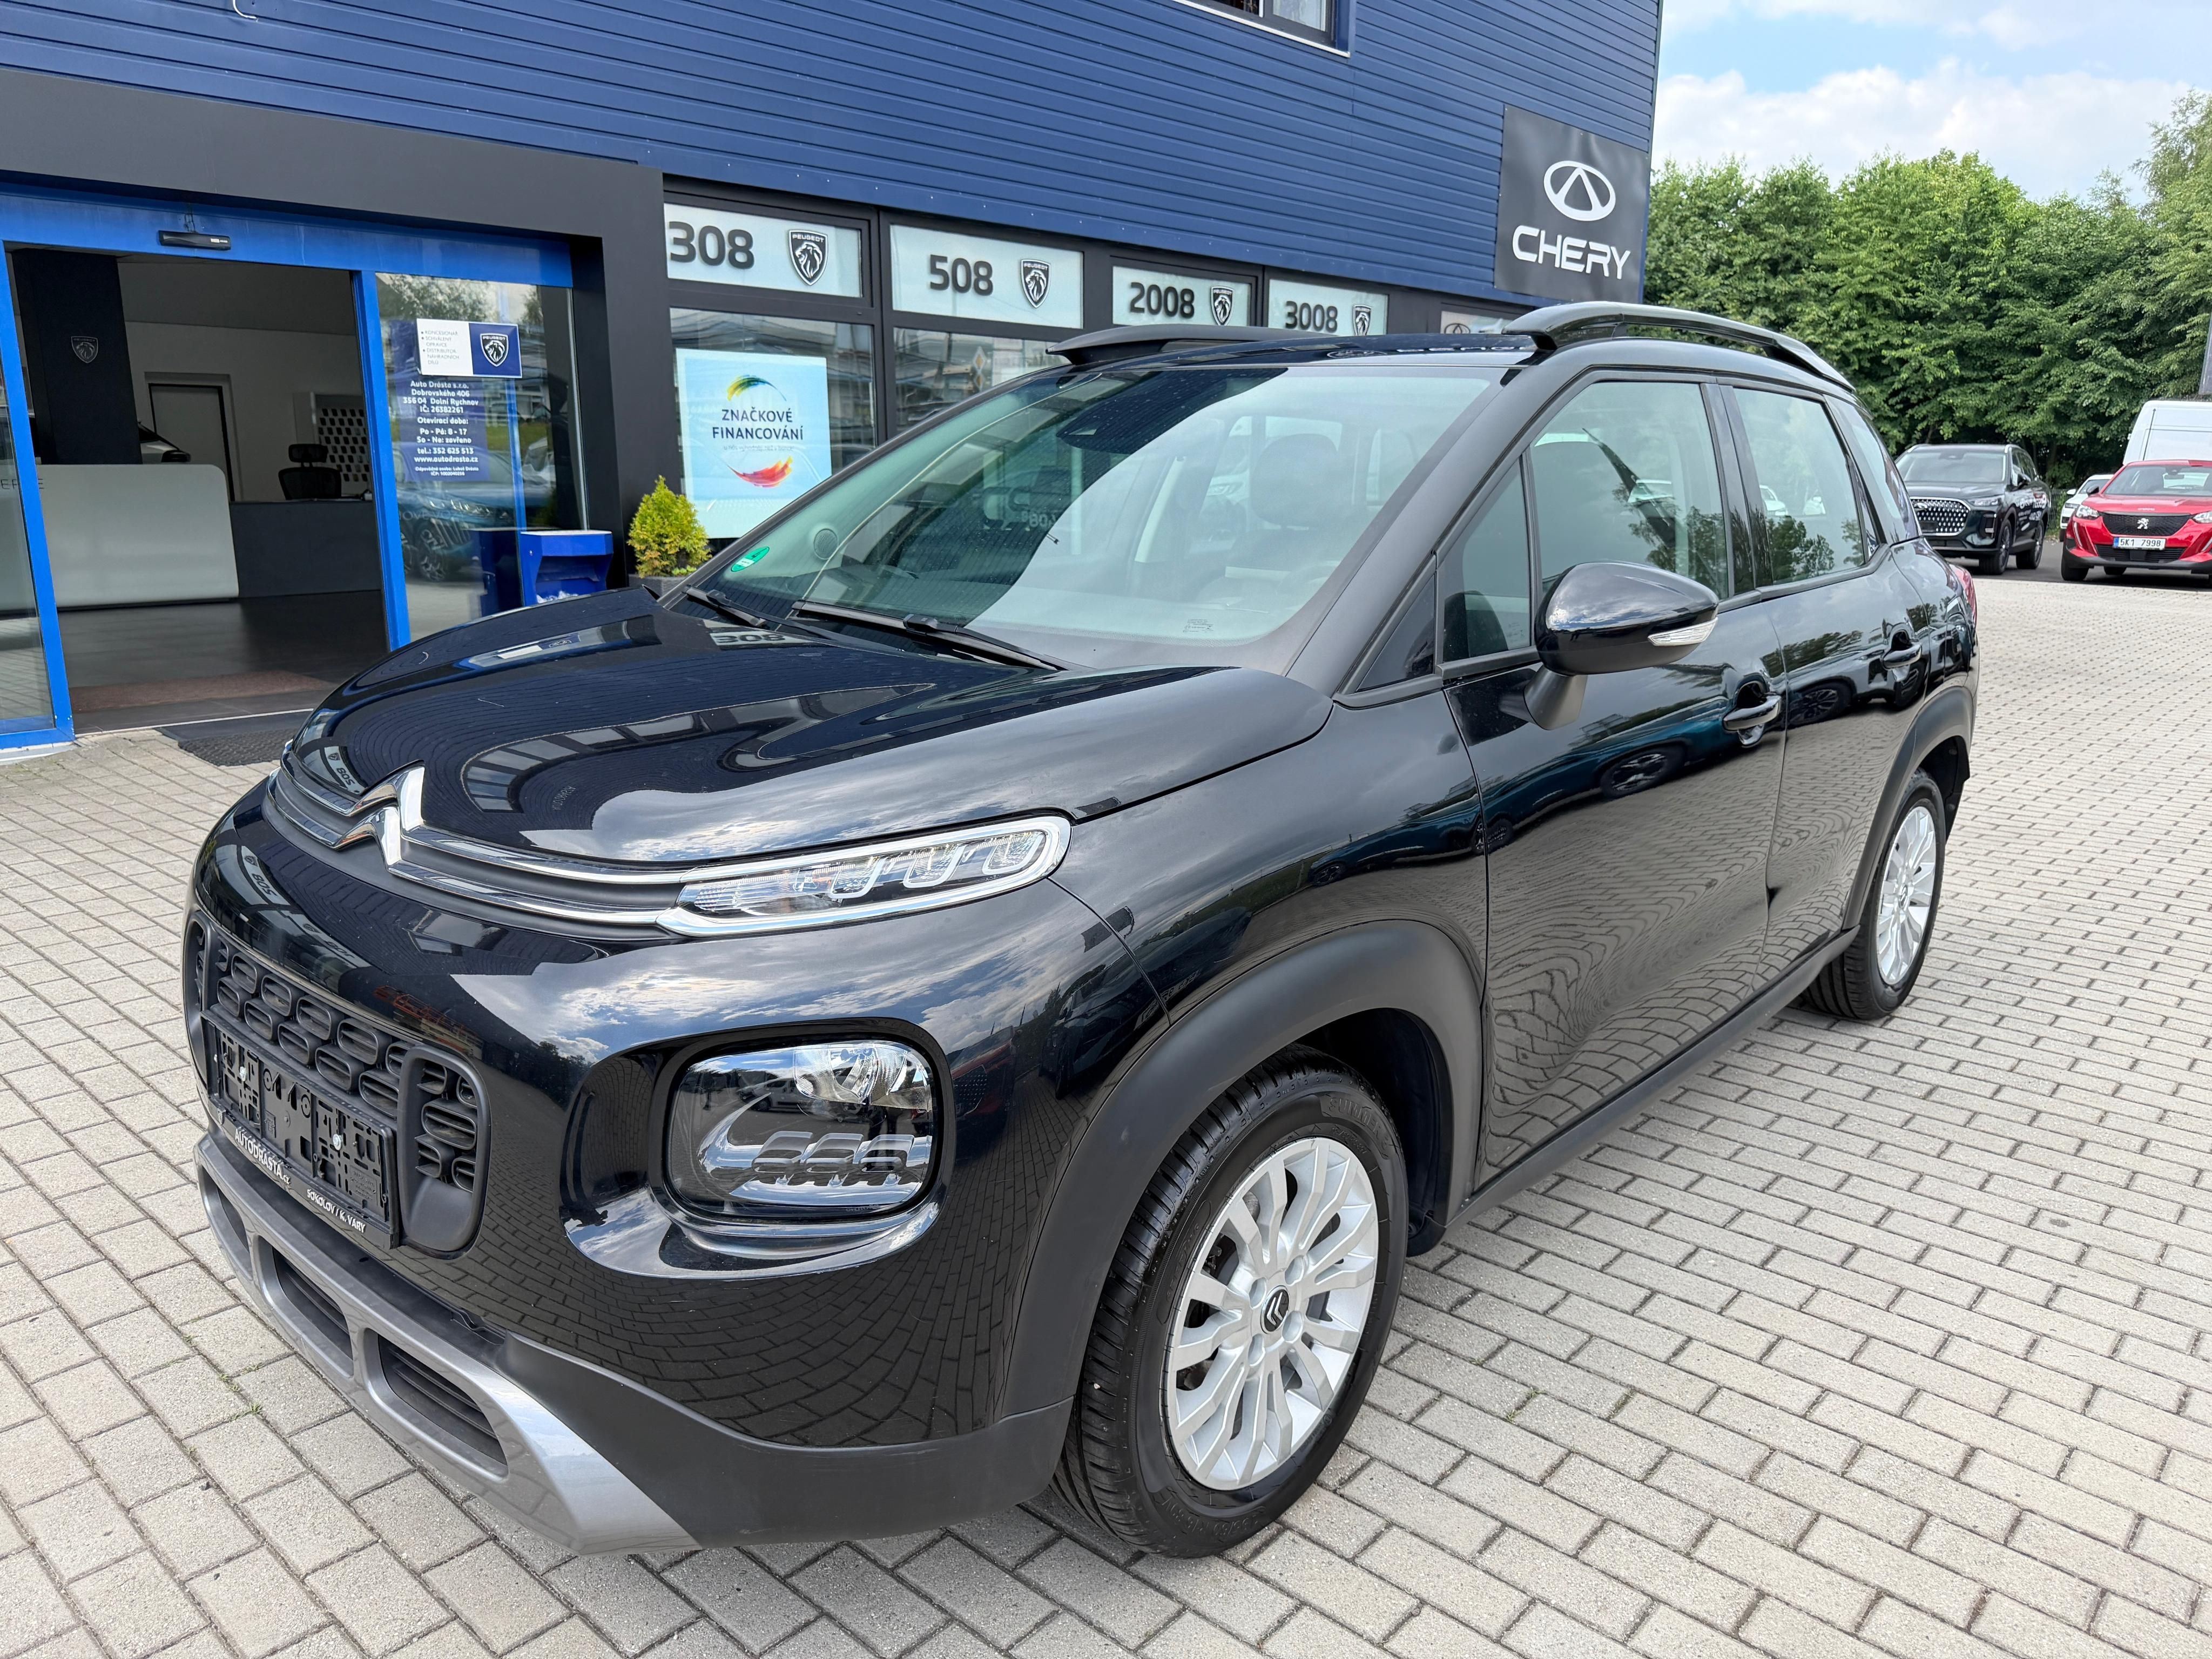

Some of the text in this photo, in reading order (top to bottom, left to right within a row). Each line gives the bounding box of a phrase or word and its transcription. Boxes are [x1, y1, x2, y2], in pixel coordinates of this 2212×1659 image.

[669, 221, 755, 269] 308
[792, 234, 824, 242] PEUGEOT
[1513, 225, 1631, 280] CHERY
[930, 254, 993, 296] 508
[1130, 282, 1195, 319] 2008
[1285, 301, 1338, 333] 3008
[712, 425, 804, 440] FINANCOVÁNÍ
[721, 407, 793, 422] ZNAČKOVÉ
[2120, 538, 2135, 547] 5K1
[235, 1127, 291, 1184] AUTODRASTA.cz
[307, 1189, 336, 1214] SOKOLOV
[347, 1215, 366, 1233] VARY
